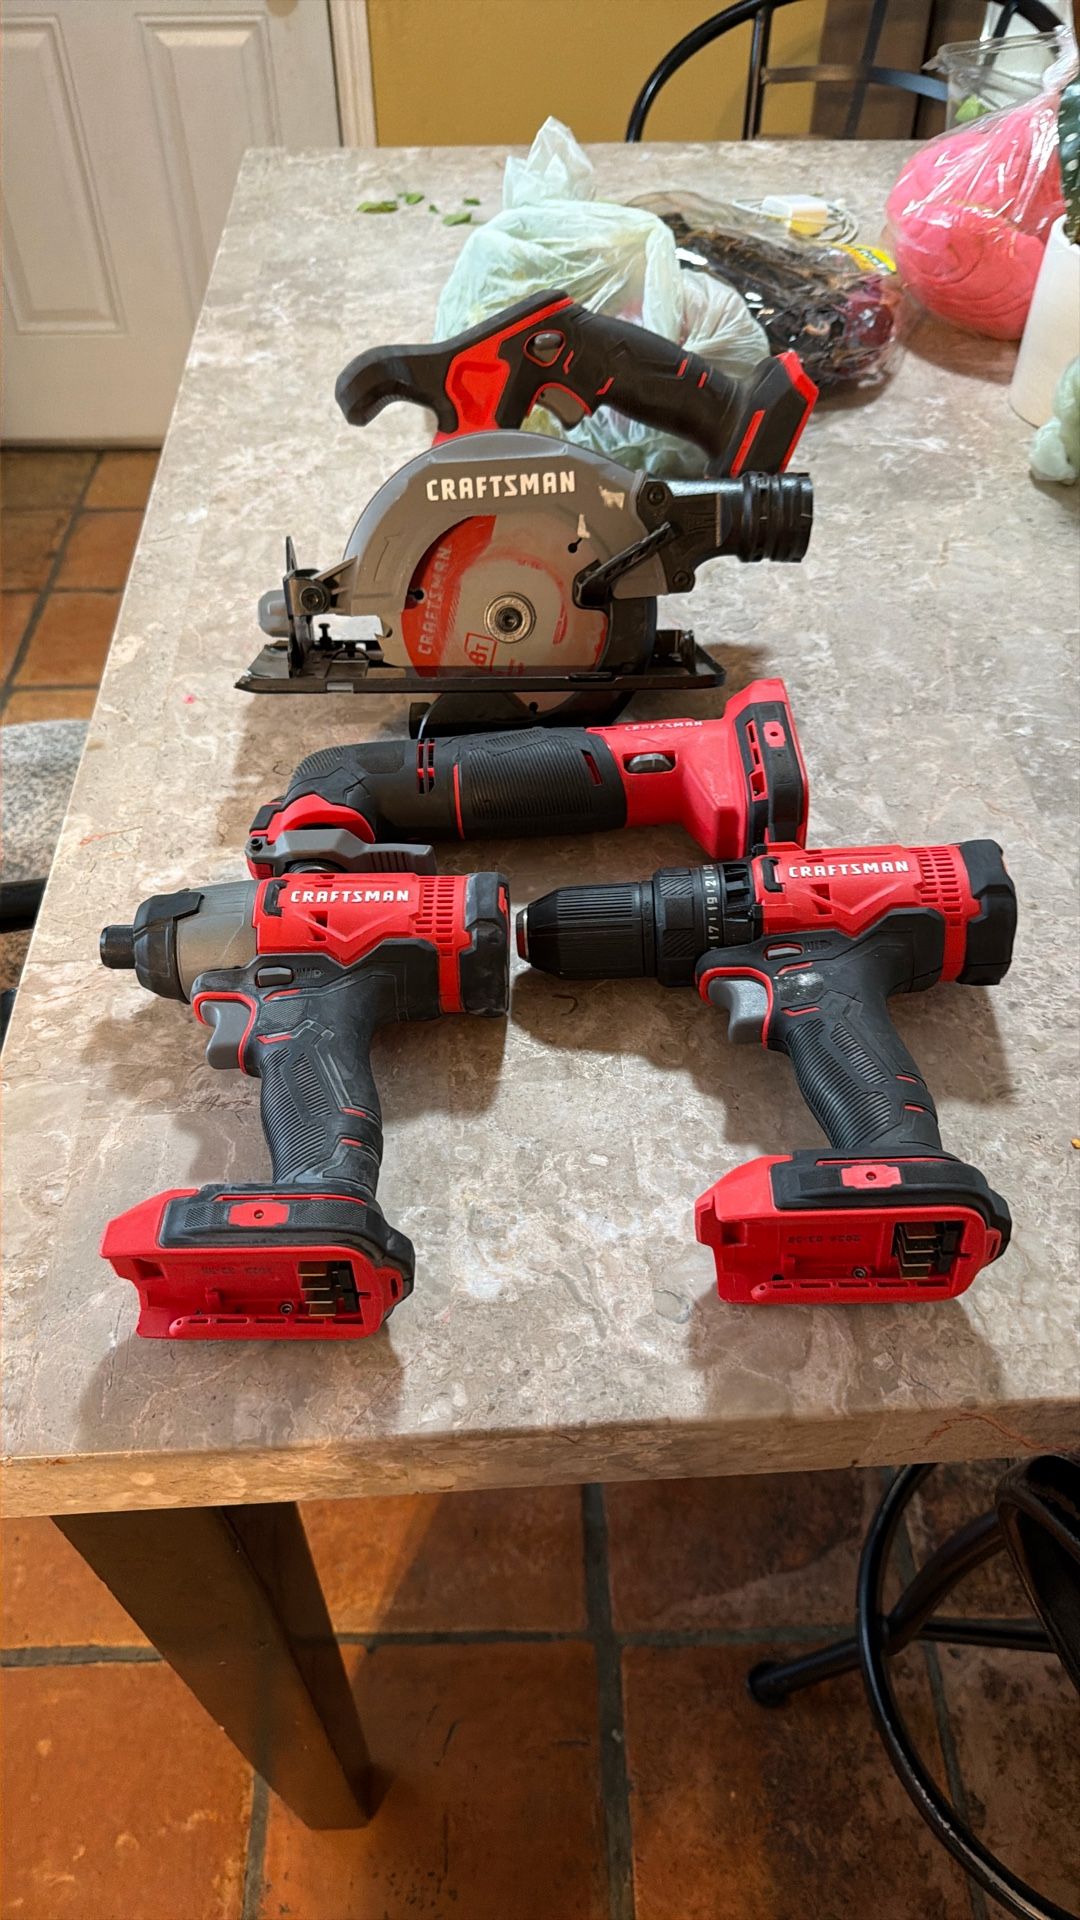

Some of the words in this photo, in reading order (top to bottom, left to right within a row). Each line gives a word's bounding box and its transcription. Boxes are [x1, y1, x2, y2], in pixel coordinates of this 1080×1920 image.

[426, 471, 575, 501] CRAFTSMAN
[417, 544, 453, 656] CRAFTSMAN
[624, 720, 704, 732] CRAFTSMAN
[788, 860, 909, 878] CRAFTSMAN
[290, 889, 410, 904] CRAFTSMAN
[706, 896, 719, 911] 19
[708, 925, 720, 940] 17
